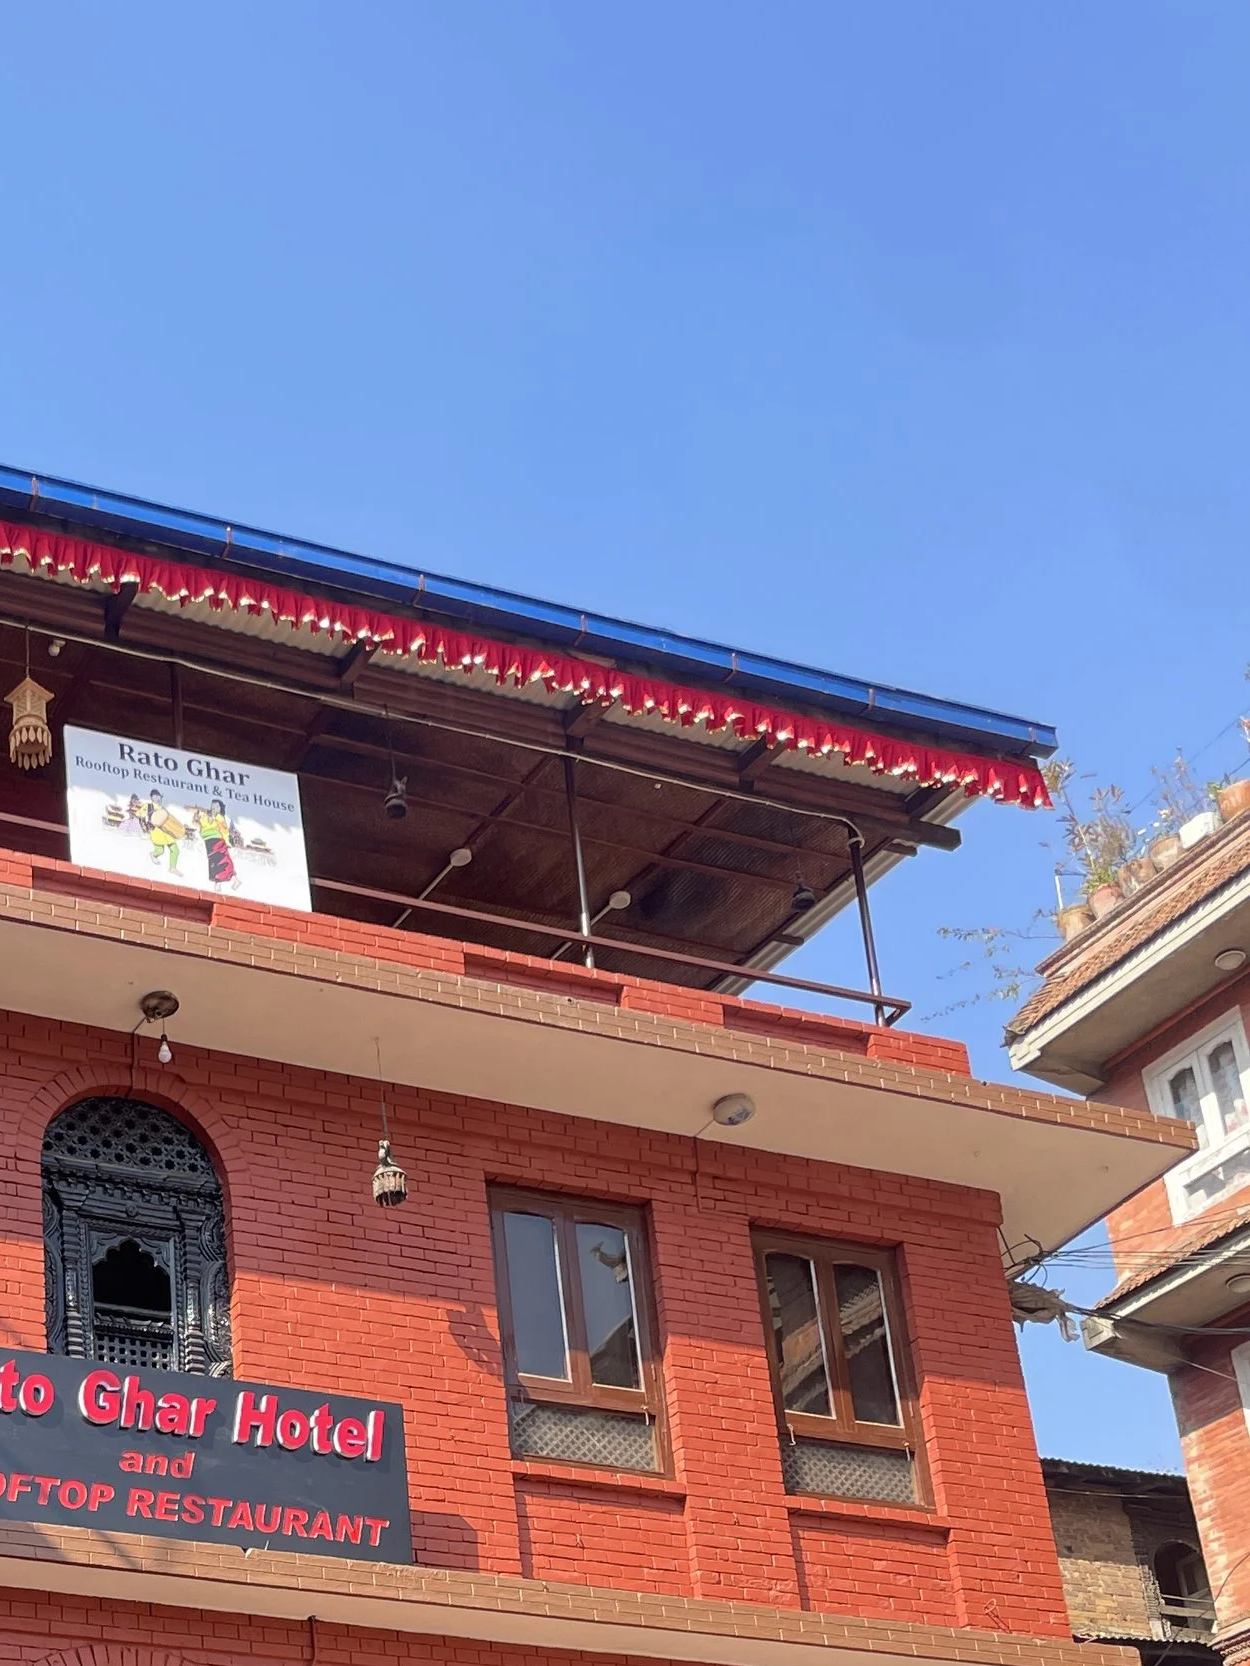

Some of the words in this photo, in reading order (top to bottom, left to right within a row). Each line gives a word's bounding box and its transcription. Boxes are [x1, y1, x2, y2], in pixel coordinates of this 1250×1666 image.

[75, 755, 130, 778] Rooftop
[133, 769, 209, 795] Restaurant
[213, 785, 223, 798] &
[226, 788, 250, 803] Tea
[253, 793, 295, 812] House
[119, 742, 178, 771] Rato
[187, 758, 250, 786] Ghar
[78, 1369, 217, 1438] Ghar
[232, 1391, 386, 1462] Hotel
[118, 1451, 196, 1479] and
[126, 1487, 390, 1547] RESTAURANT
